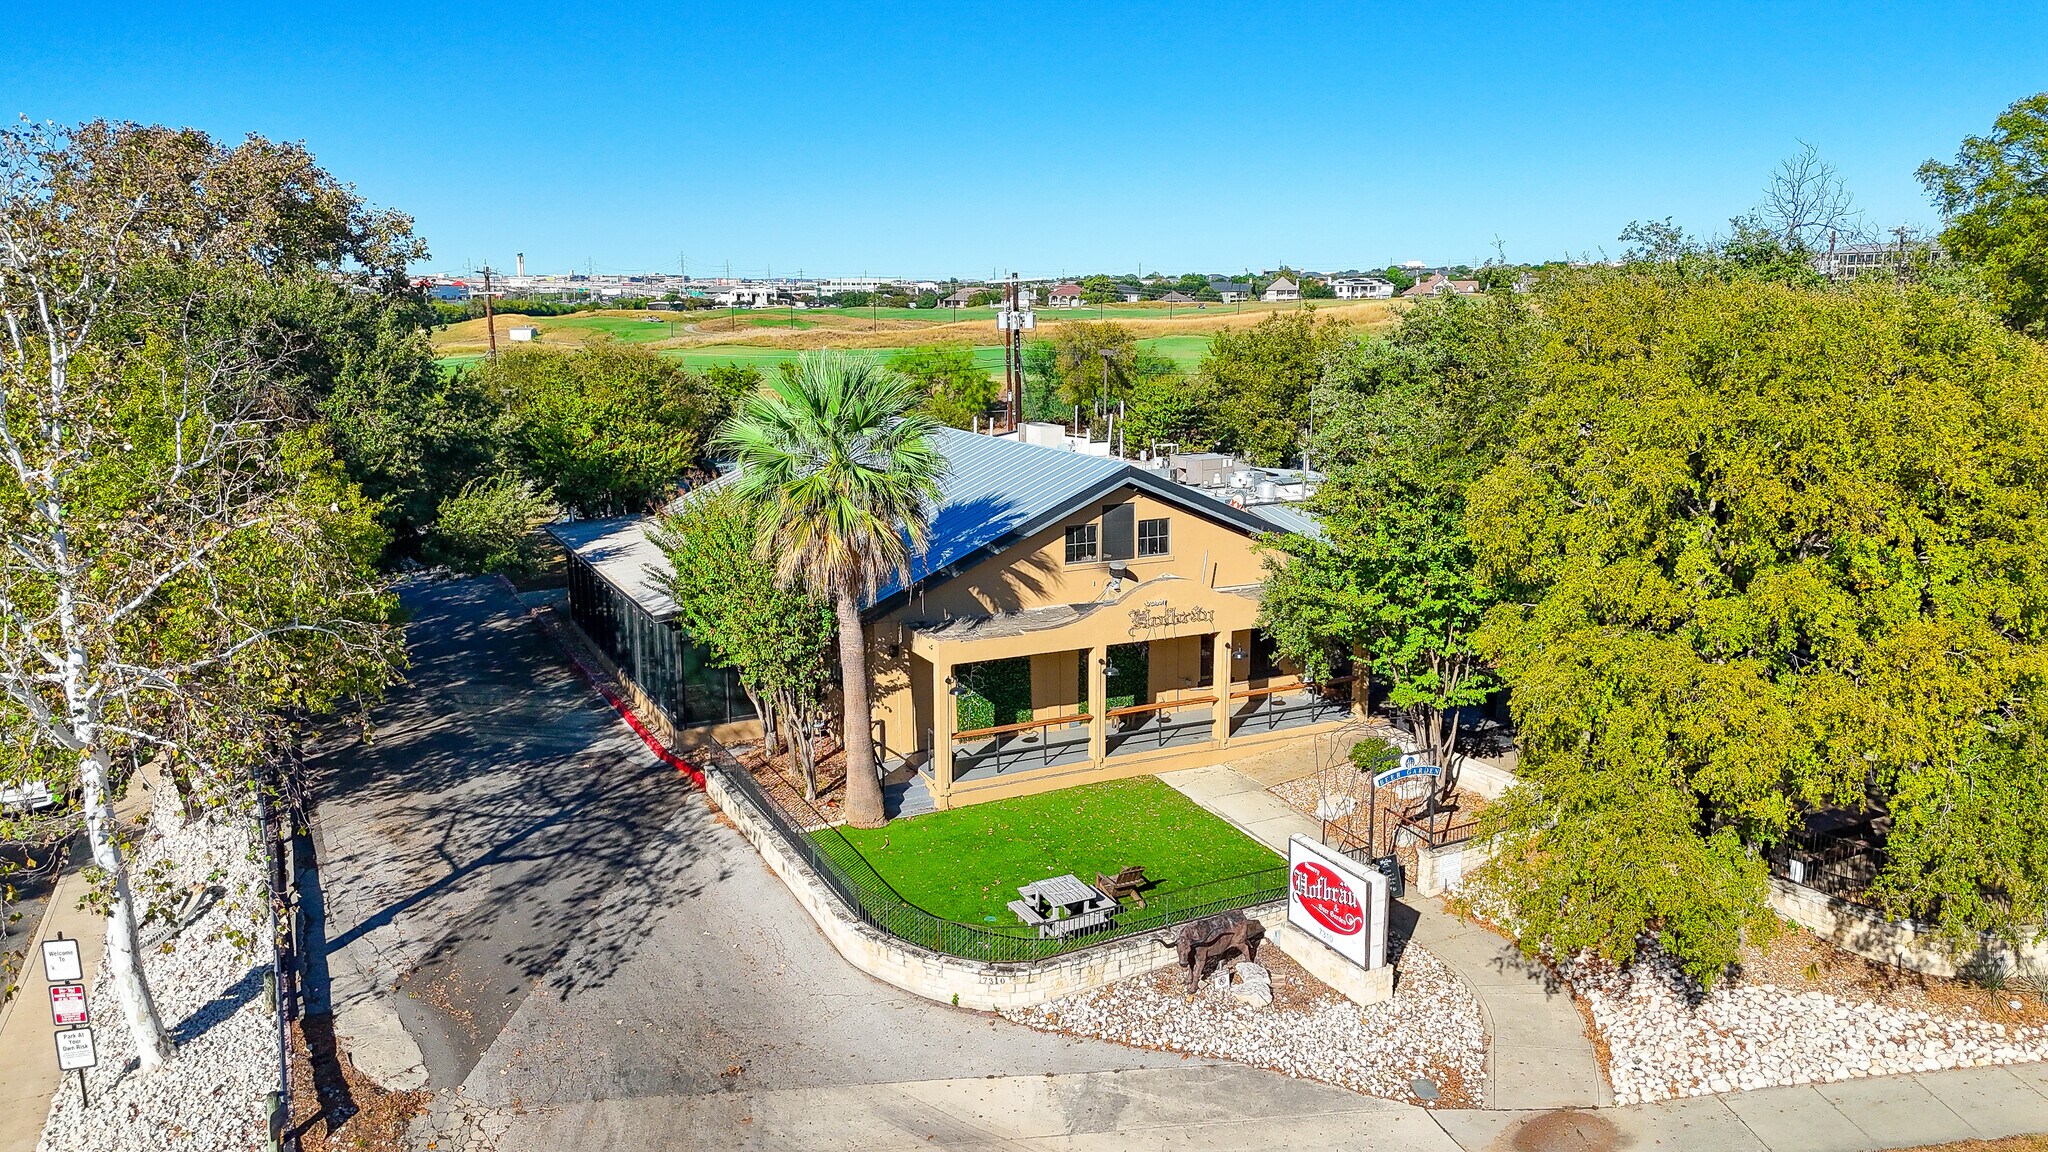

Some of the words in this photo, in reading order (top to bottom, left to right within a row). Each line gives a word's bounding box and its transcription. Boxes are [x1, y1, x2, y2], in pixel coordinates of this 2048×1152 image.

[1378, 771, 1401, 787] BEER
[1406, 766, 1440, 776] GARDEN
[1293, 868, 1358, 908] Hofbräu
[1333, 903, 1340, 914] &
